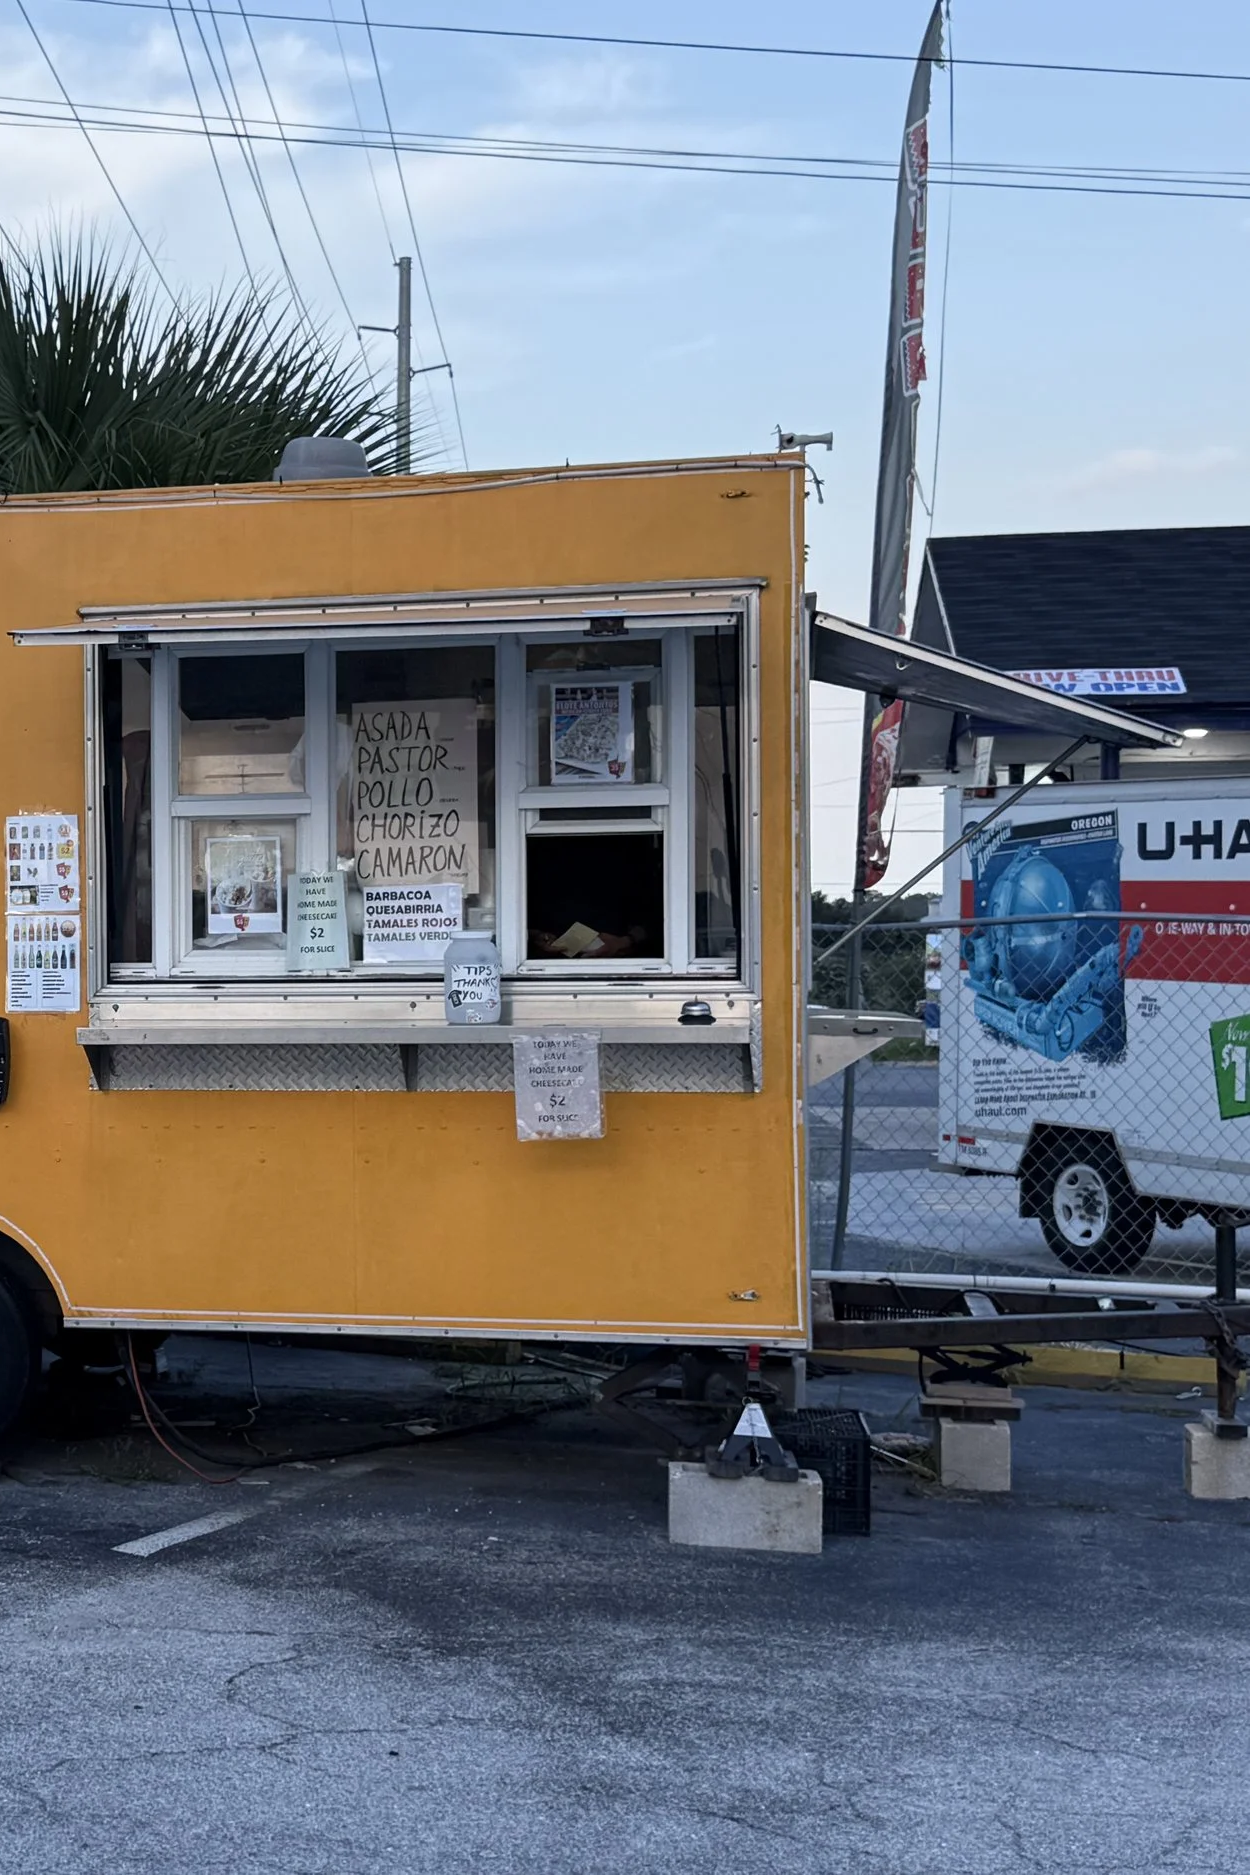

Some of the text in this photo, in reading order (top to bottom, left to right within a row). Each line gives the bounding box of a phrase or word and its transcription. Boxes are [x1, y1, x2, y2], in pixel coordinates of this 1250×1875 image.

[1011, 670, 1177, 682] RIVE-THRU
[1091, 682, 1181, 692] OPEN
[355, 711, 431, 742] ASADA
[358, 745, 449, 774] PASTOR
[358, 777, 434, 810] POLLO
[1071, 815, 1112, 830] OREGON
[357, 844, 466, 879] CAMARON
[366, 891, 432, 901] BARBACOA
[366, 904, 444, 916] QUESABIRRIA
[366, 918, 458, 929] TAMALES ROJOS
[1207, 922, 1216, 934] &
[310, 927, 324, 939] $2
[366, 932, 416, 942] TAMALES
[463, 966, 492, 976] TIPS
[454, 979, 491, 988] THANK
[462, 990, 482, 1000] YOU
[550, 1094, 566, 1108] $2
[975, 1107, 1027, 1117] uhaul.com
